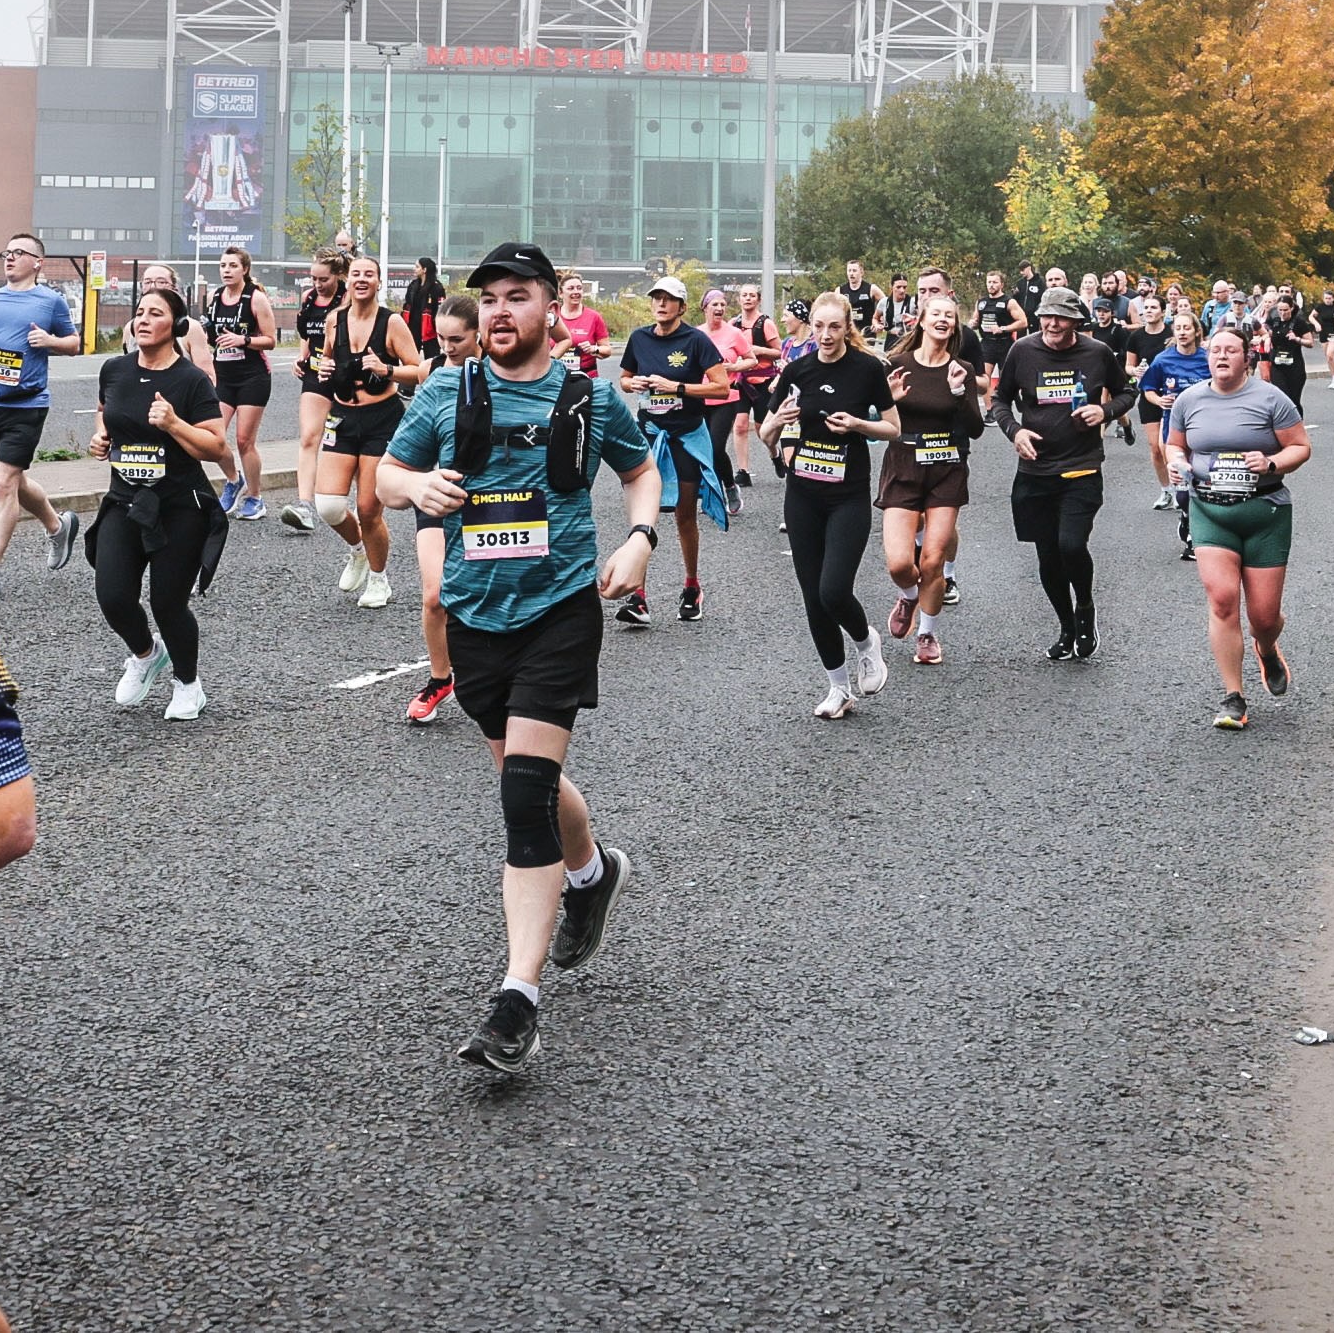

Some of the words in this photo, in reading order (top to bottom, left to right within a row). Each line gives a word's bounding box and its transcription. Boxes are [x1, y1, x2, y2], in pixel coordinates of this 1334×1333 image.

[426, 46, 624, 69] MANCHESTER
[644, 51, 749, 74] UNITED
[197, 76, 256, 88] BETFRED
[219, 94, 254, 104] SUPER
[219, 104, 254, 113] LEAGUE
[1045, 378, 1074, 386] CALUM
[1048, 389, 1072, 398] 21171
[650, 398, 675, 406] 19482
[925, 440, 949, 448] HOLLY
[120, 453, 157, 463] DANILA
[815, 451, 845, 462] DOHERTY
[924, 451, 952, 460] 19099
[121, 468, 155, 478] 28192
[804, 463, 834, 475] 21242
[1218, 473, 1251, 482] 27408
[480, 493, 502, 503] MCR
[503, 492, 533, 502] HALF
[476, 530, 530, 547] 30813
